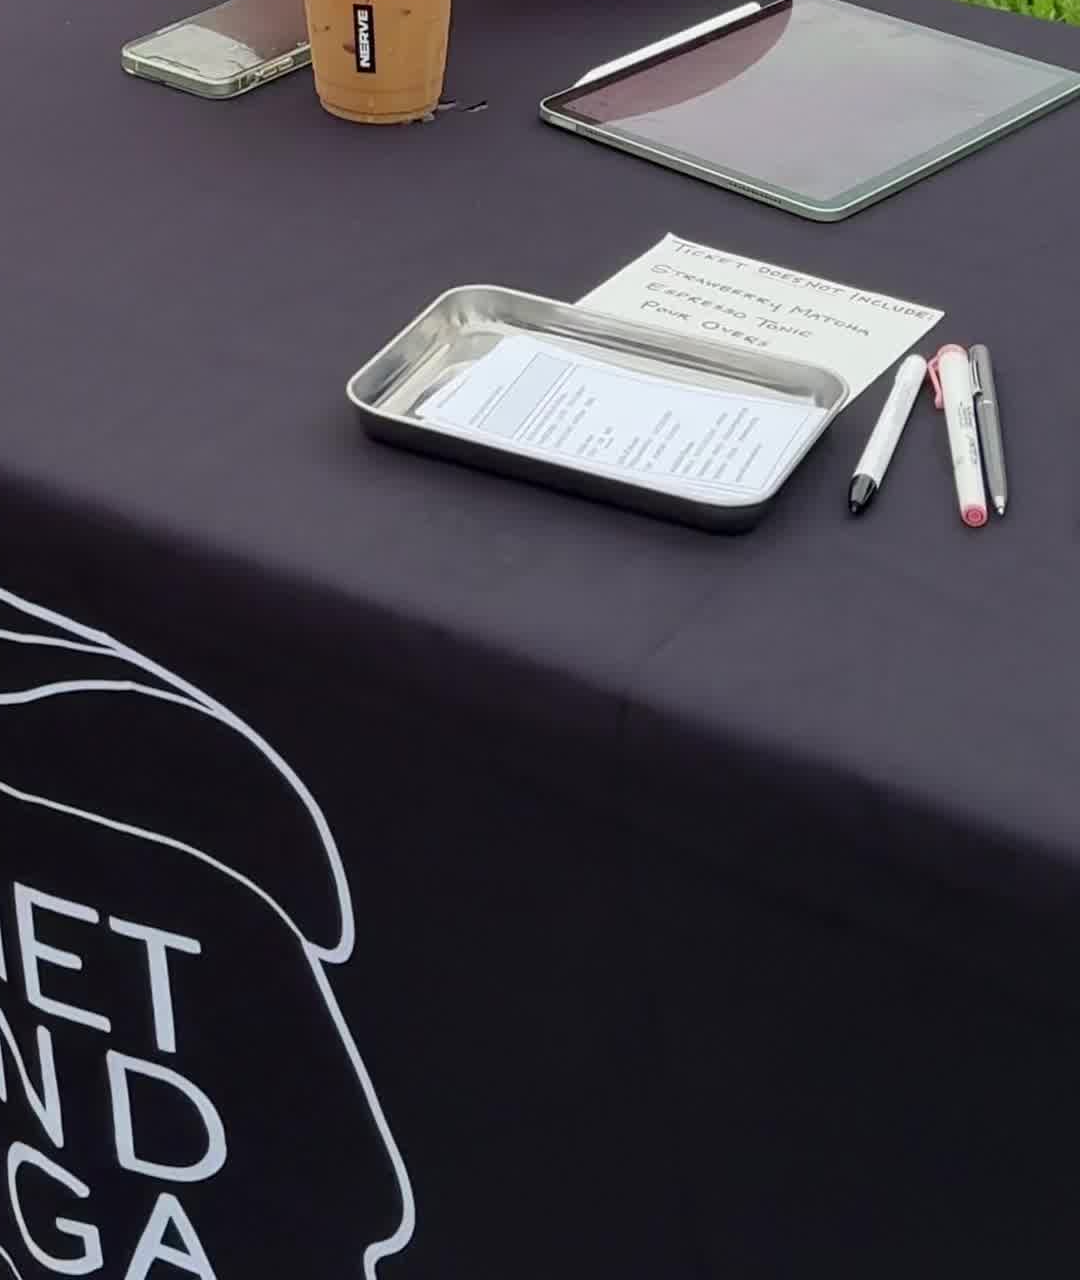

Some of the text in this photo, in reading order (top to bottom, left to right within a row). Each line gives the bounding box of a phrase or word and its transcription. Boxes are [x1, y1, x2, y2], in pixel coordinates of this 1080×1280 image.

[358, 9, 371, 68] NERVE
[671, 239, 749, 269] TICKET
[758, 266, 804, 284] DOES
[805, 281, 846, 295] NOT
[640, 299, 691, 321] POUR
[645, 281, 816, 338] ESPRESSO TONIC
[650, 263, 870, 337] STRAWBERRY MATCHA
